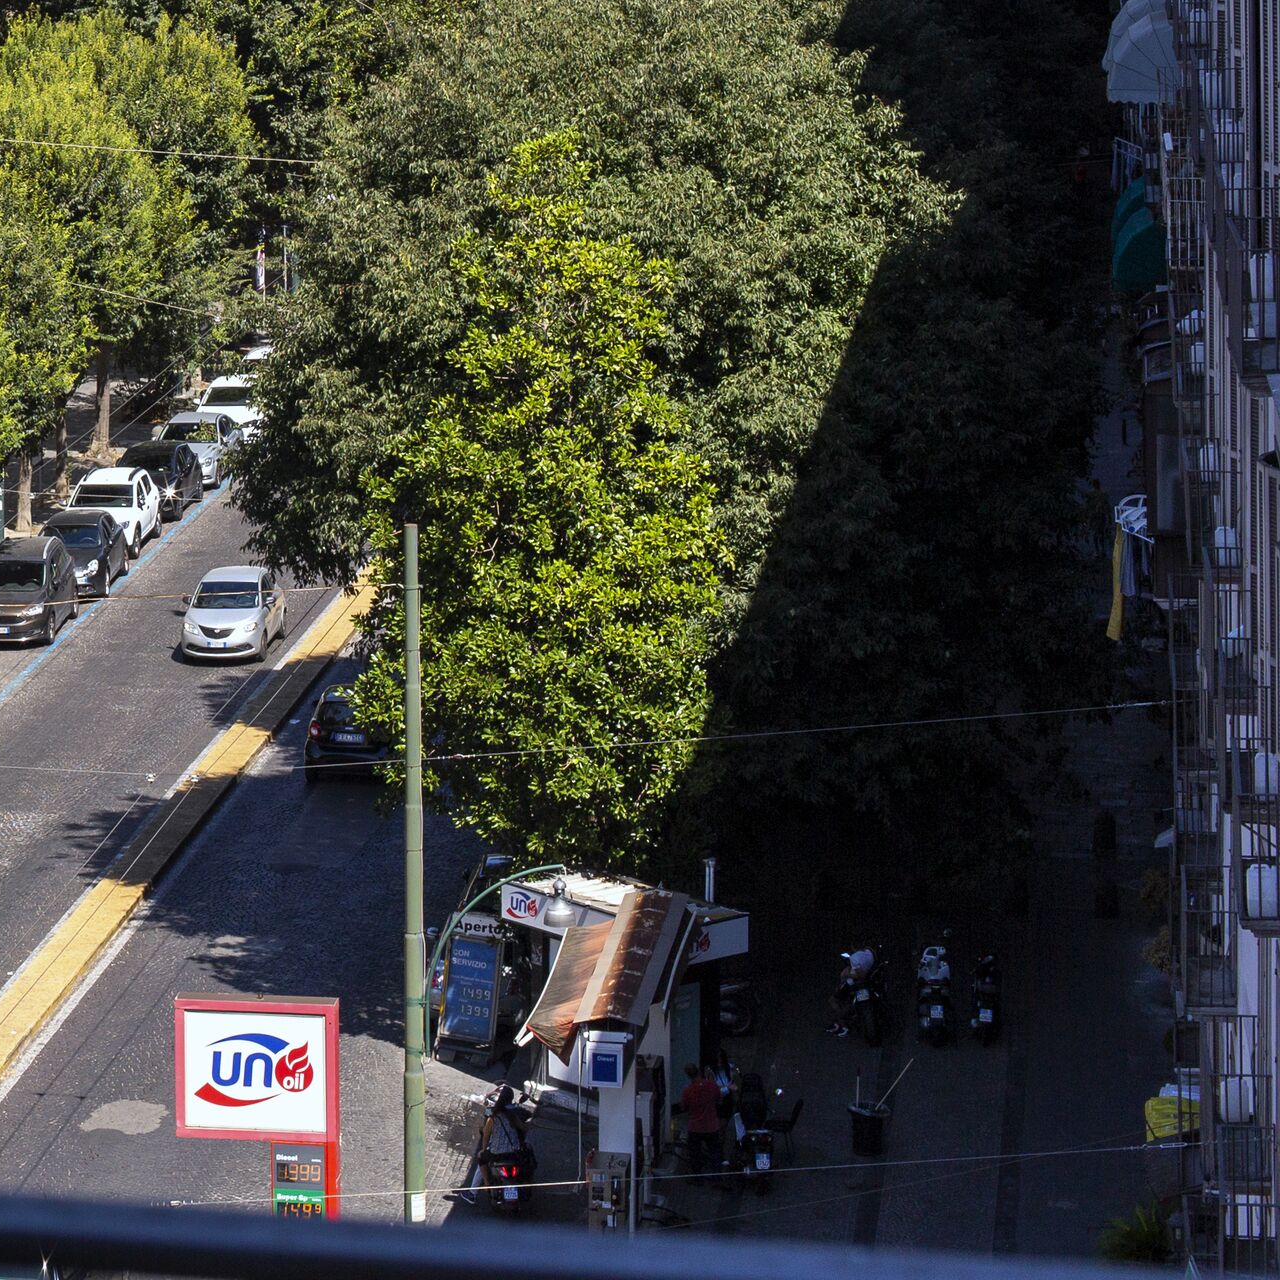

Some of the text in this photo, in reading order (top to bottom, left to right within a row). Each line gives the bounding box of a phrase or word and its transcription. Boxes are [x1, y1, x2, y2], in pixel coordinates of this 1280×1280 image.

[454, 920, 502, 935] Aperto
[453, 948, 470, 957] CON
[452, 957, 487, 969] SERVIZIO
[283, 1073, 305, 1090] oil
